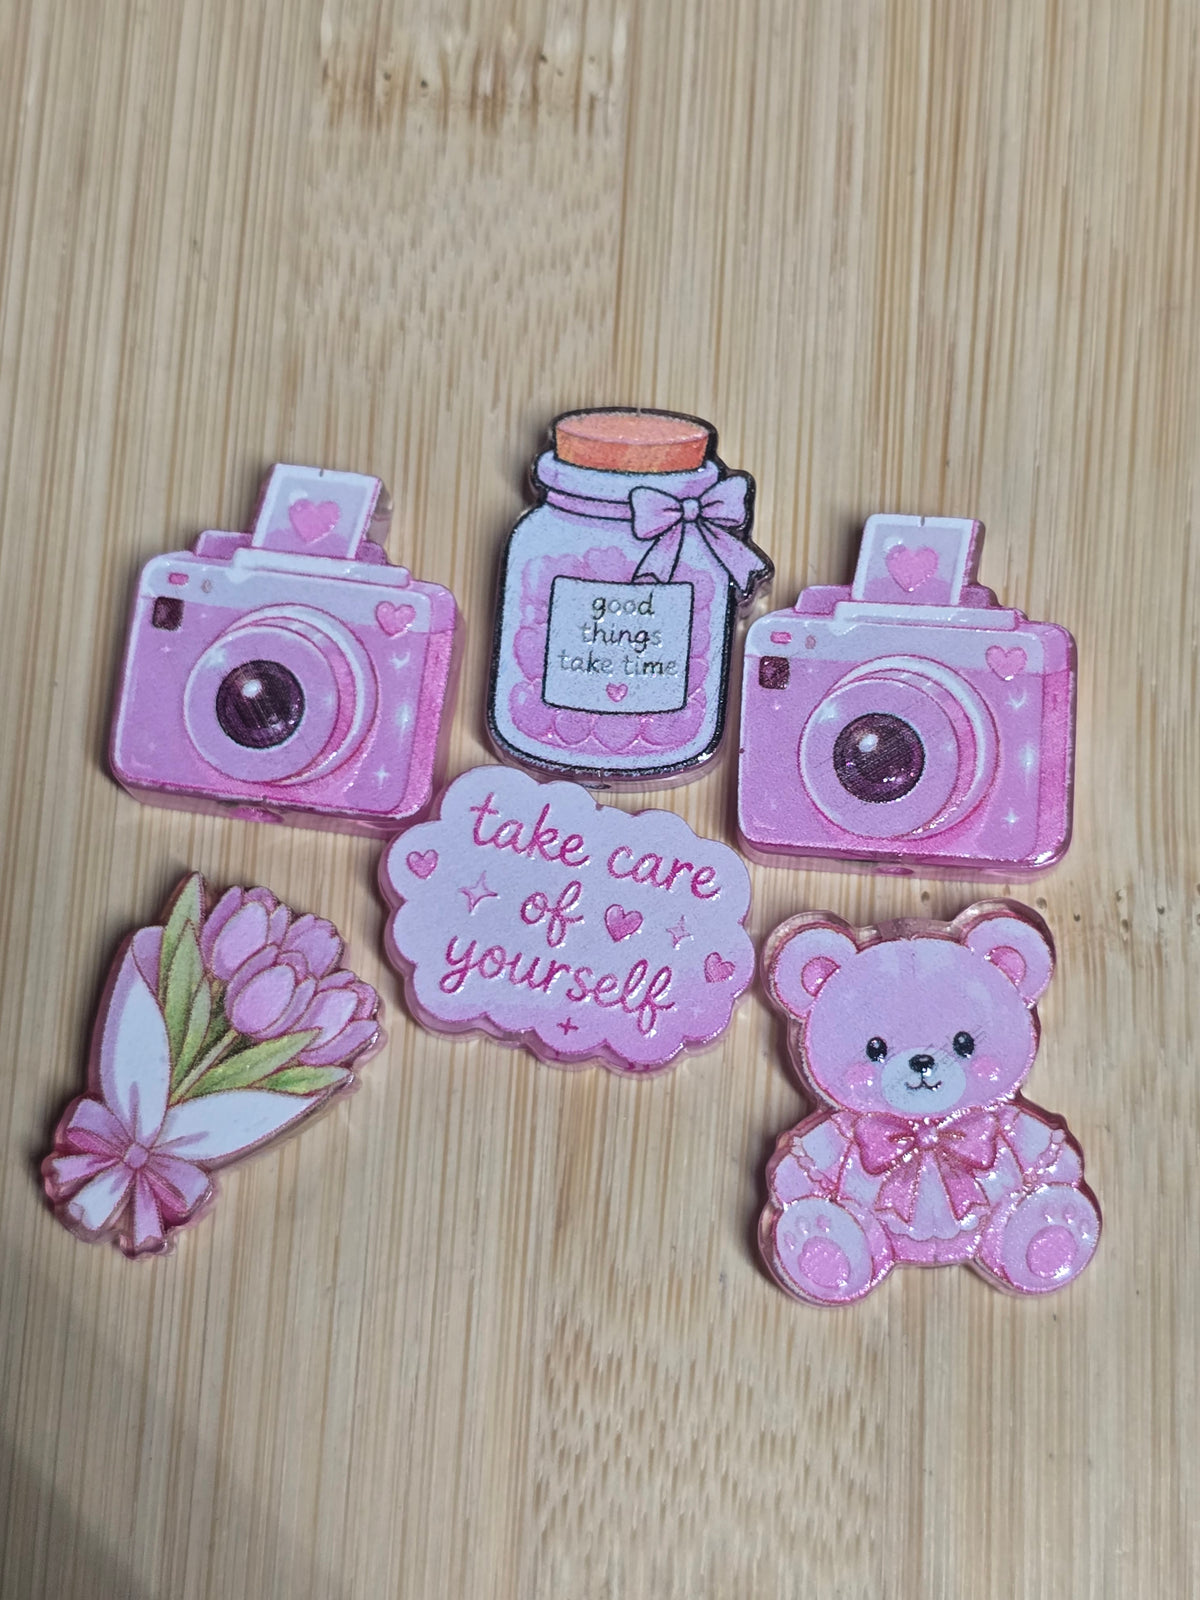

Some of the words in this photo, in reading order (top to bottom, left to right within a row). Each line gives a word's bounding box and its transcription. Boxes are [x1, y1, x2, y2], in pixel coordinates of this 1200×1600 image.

[592, 591, 655, 620] good
[578, 622, 662, 653] things
[558, 649, 613, 675] take
[622, 654, 678, 676] time
[470, 792, 590, 867] take
[607, 846, 722, 900] care
[520, 880, 585, 948] of
[439, 936, 676, 1036] yourself
